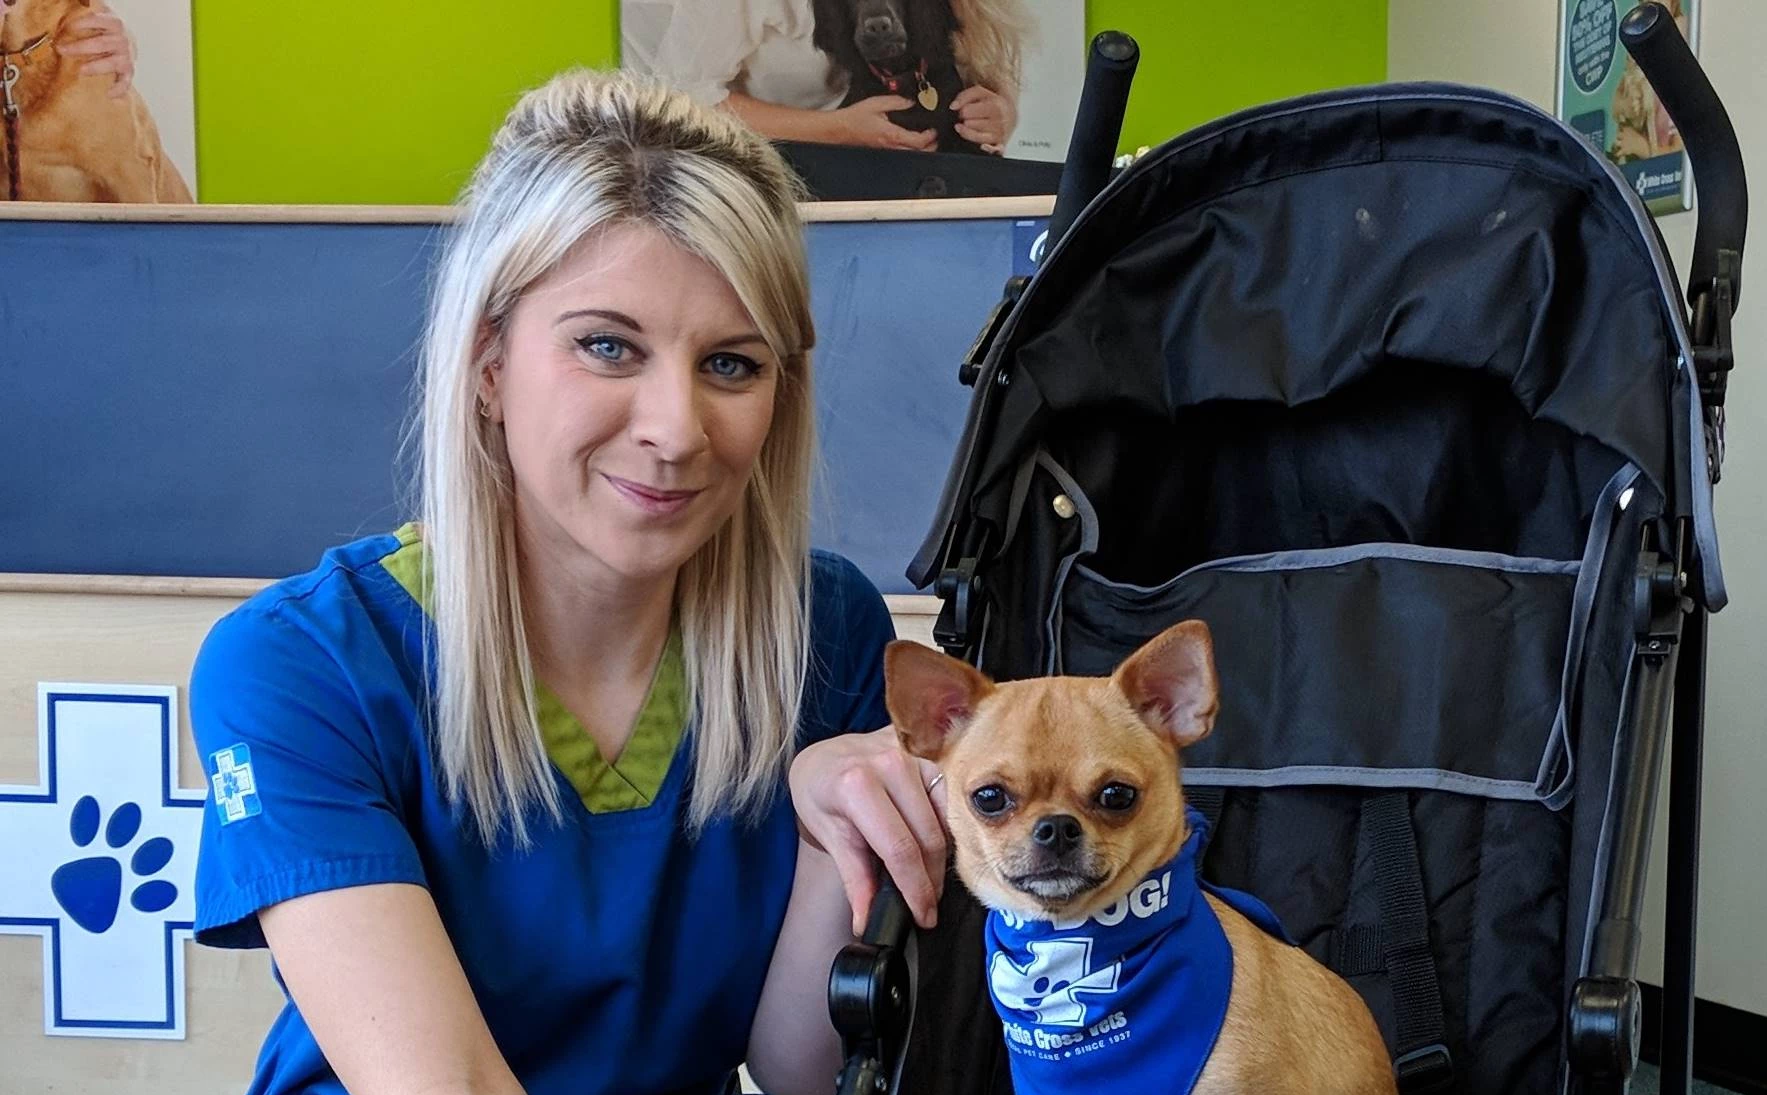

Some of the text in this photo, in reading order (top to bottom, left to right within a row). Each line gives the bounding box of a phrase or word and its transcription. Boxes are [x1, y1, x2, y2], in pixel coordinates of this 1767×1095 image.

[1053, 870, 1171, 931] OG!
[1074, 1039, 1105, 1056] SINCE
[1108, 1030, 1131, 1045] 1937
